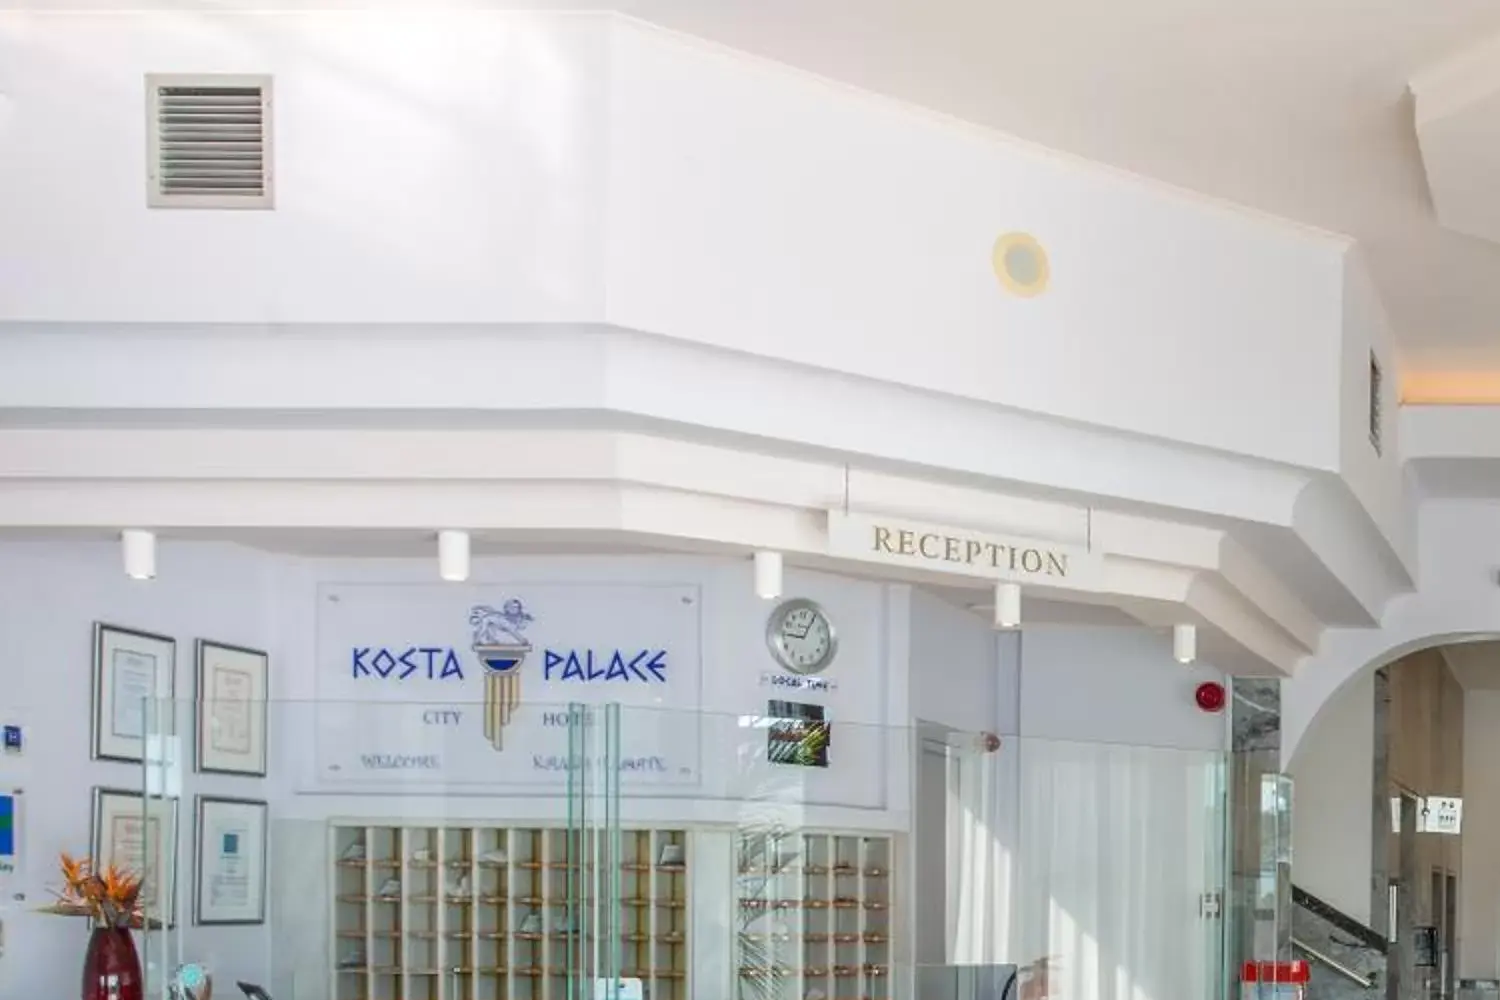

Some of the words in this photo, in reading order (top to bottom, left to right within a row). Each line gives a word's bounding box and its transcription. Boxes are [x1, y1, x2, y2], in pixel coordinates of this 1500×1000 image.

[872, 525, 1069, 577] RECEPTION
[352, 646, 464, 680] KOSTA
[544, 648, 667, 682] PALACE
[422, 710, 463, 725] CITY
